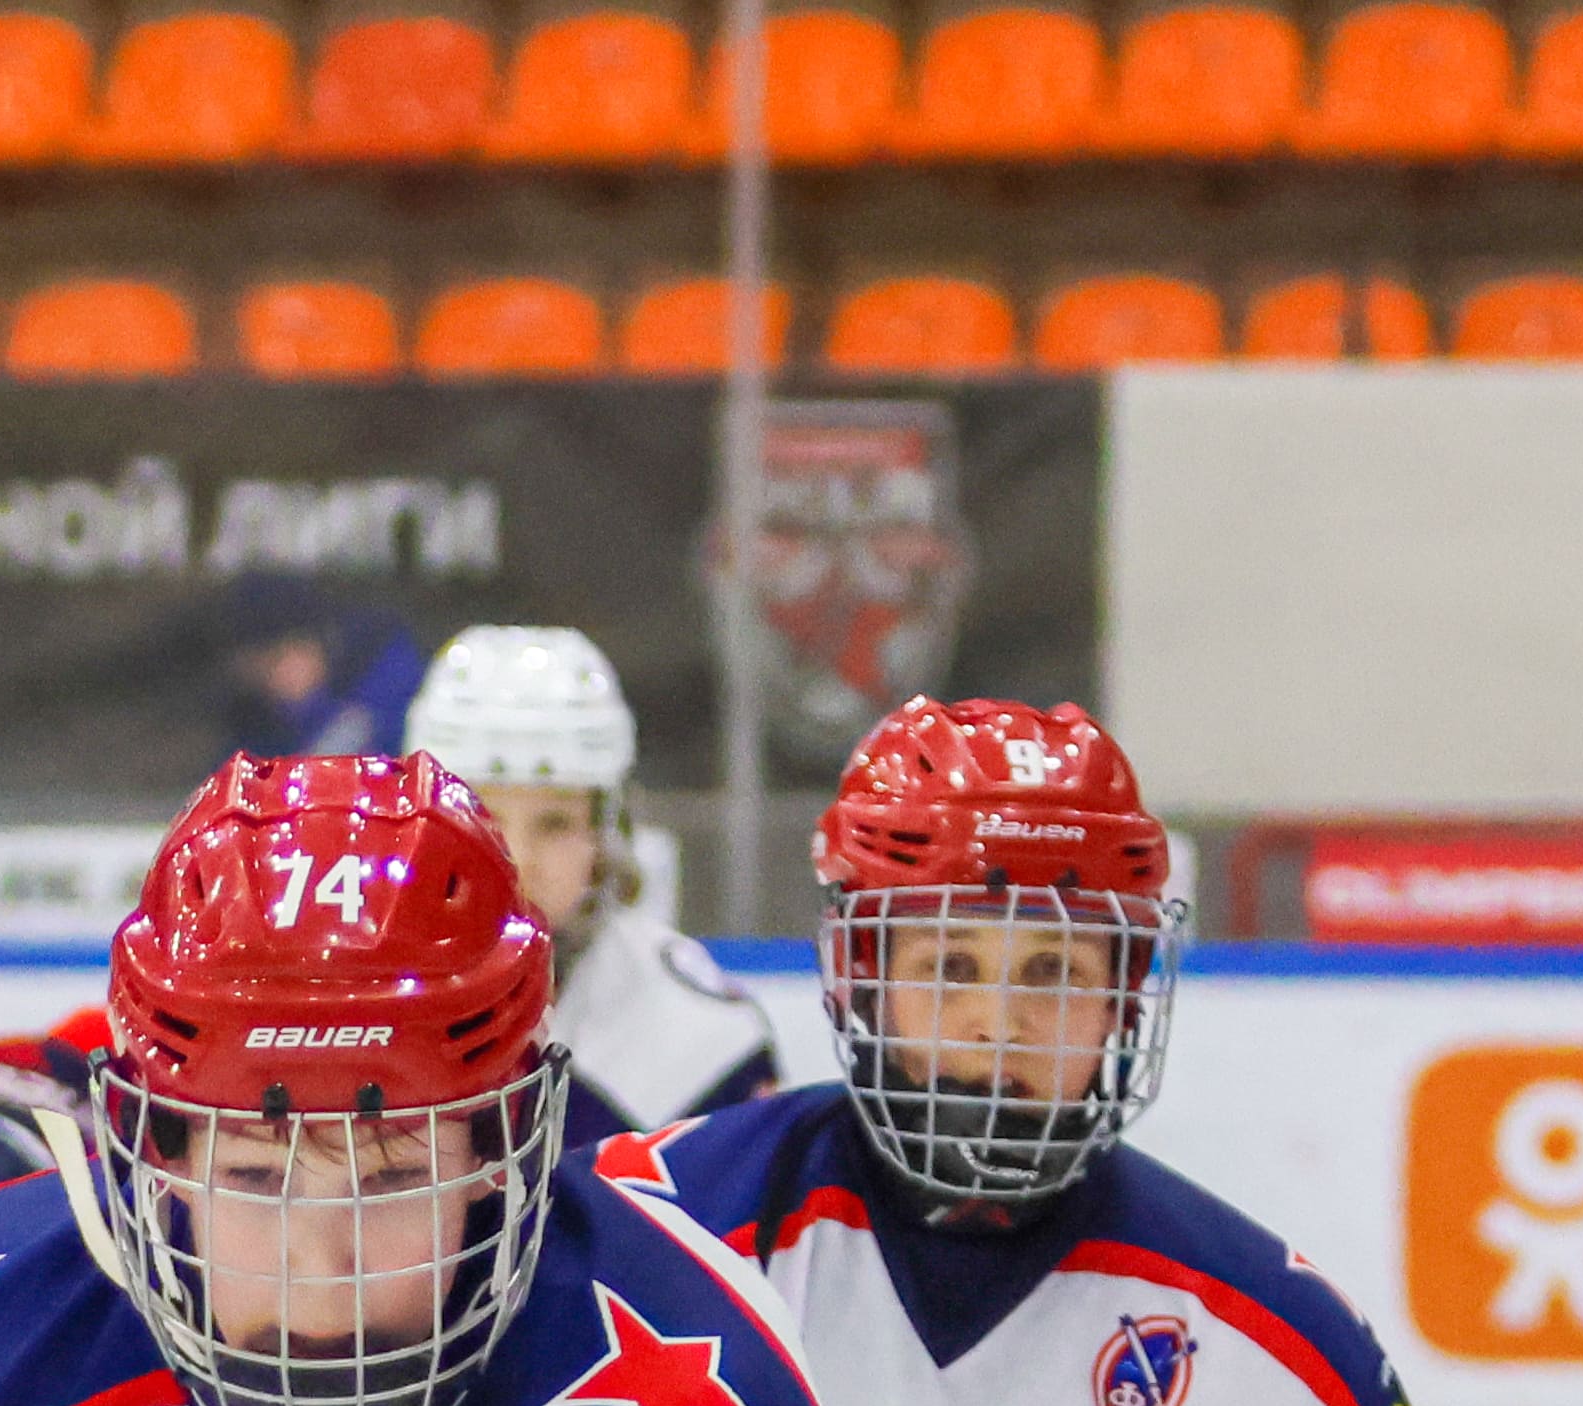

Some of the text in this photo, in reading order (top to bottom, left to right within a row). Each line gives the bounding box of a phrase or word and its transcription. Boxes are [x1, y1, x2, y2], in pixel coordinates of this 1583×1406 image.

[209, 476, 504, 576] ЛИГИ
[1006, 739, 1046, 787] 9
[272, 854, 366, 929] 74
